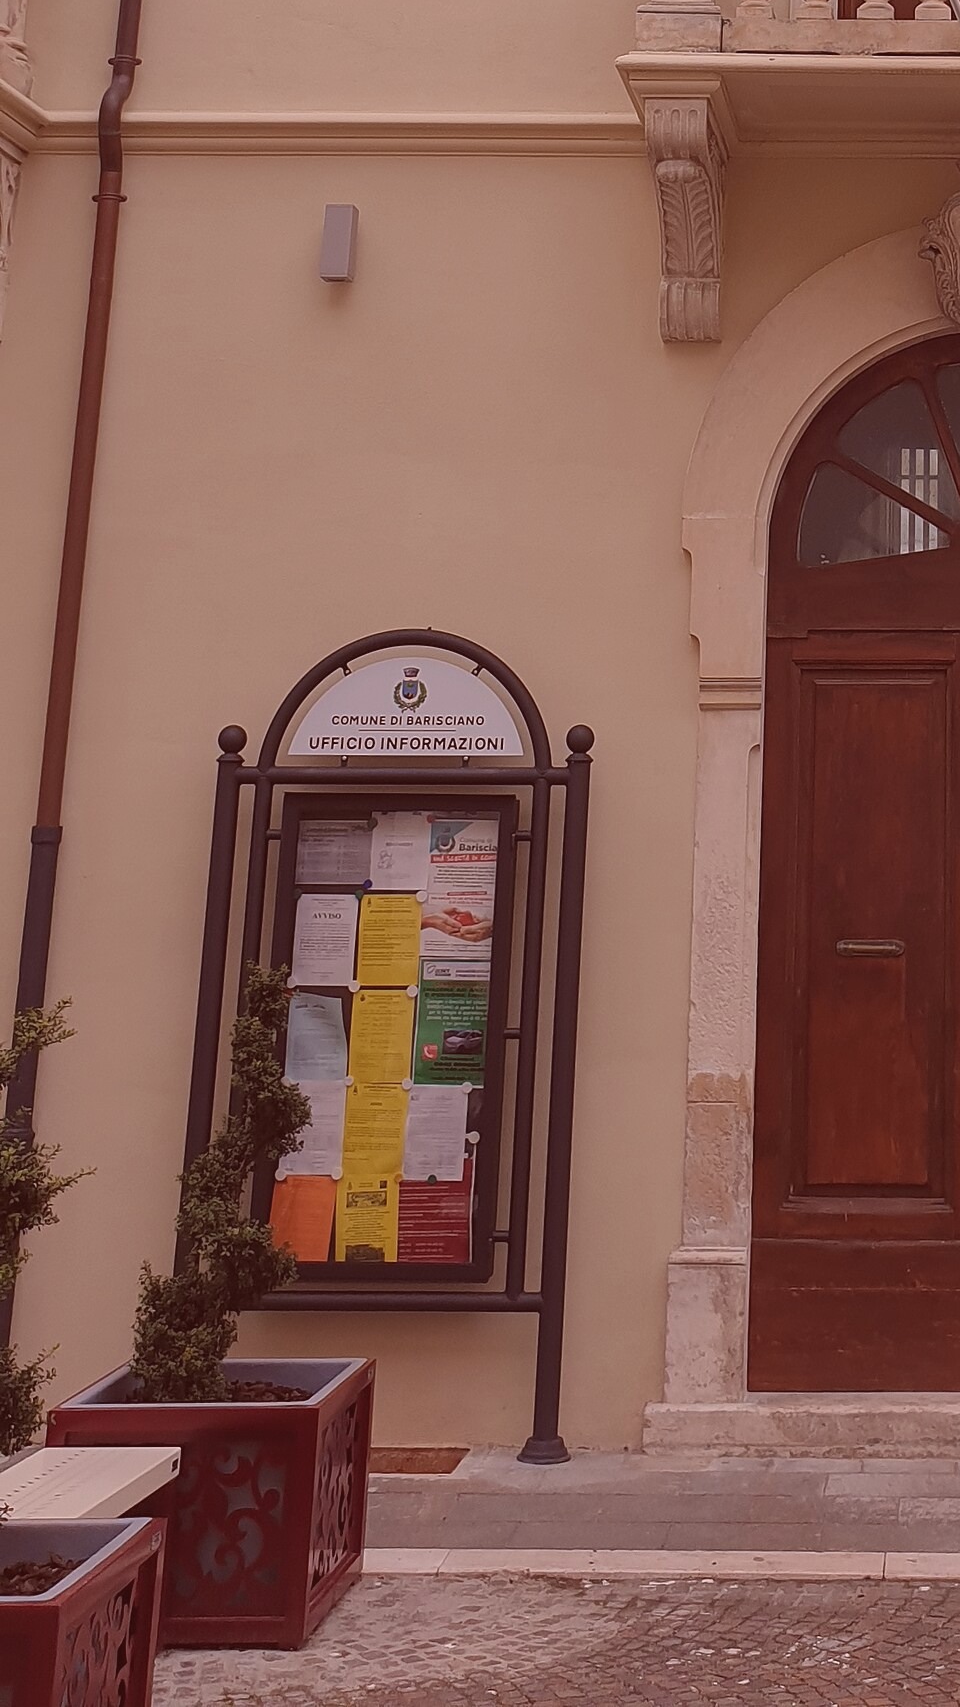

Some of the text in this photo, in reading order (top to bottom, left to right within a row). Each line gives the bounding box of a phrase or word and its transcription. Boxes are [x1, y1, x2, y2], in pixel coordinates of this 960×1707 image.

[331, 715, 485, 726] COMUNE DI BARISCIANO
[309, 736, 505, 751] UFFICIO INFORMAZIONI
